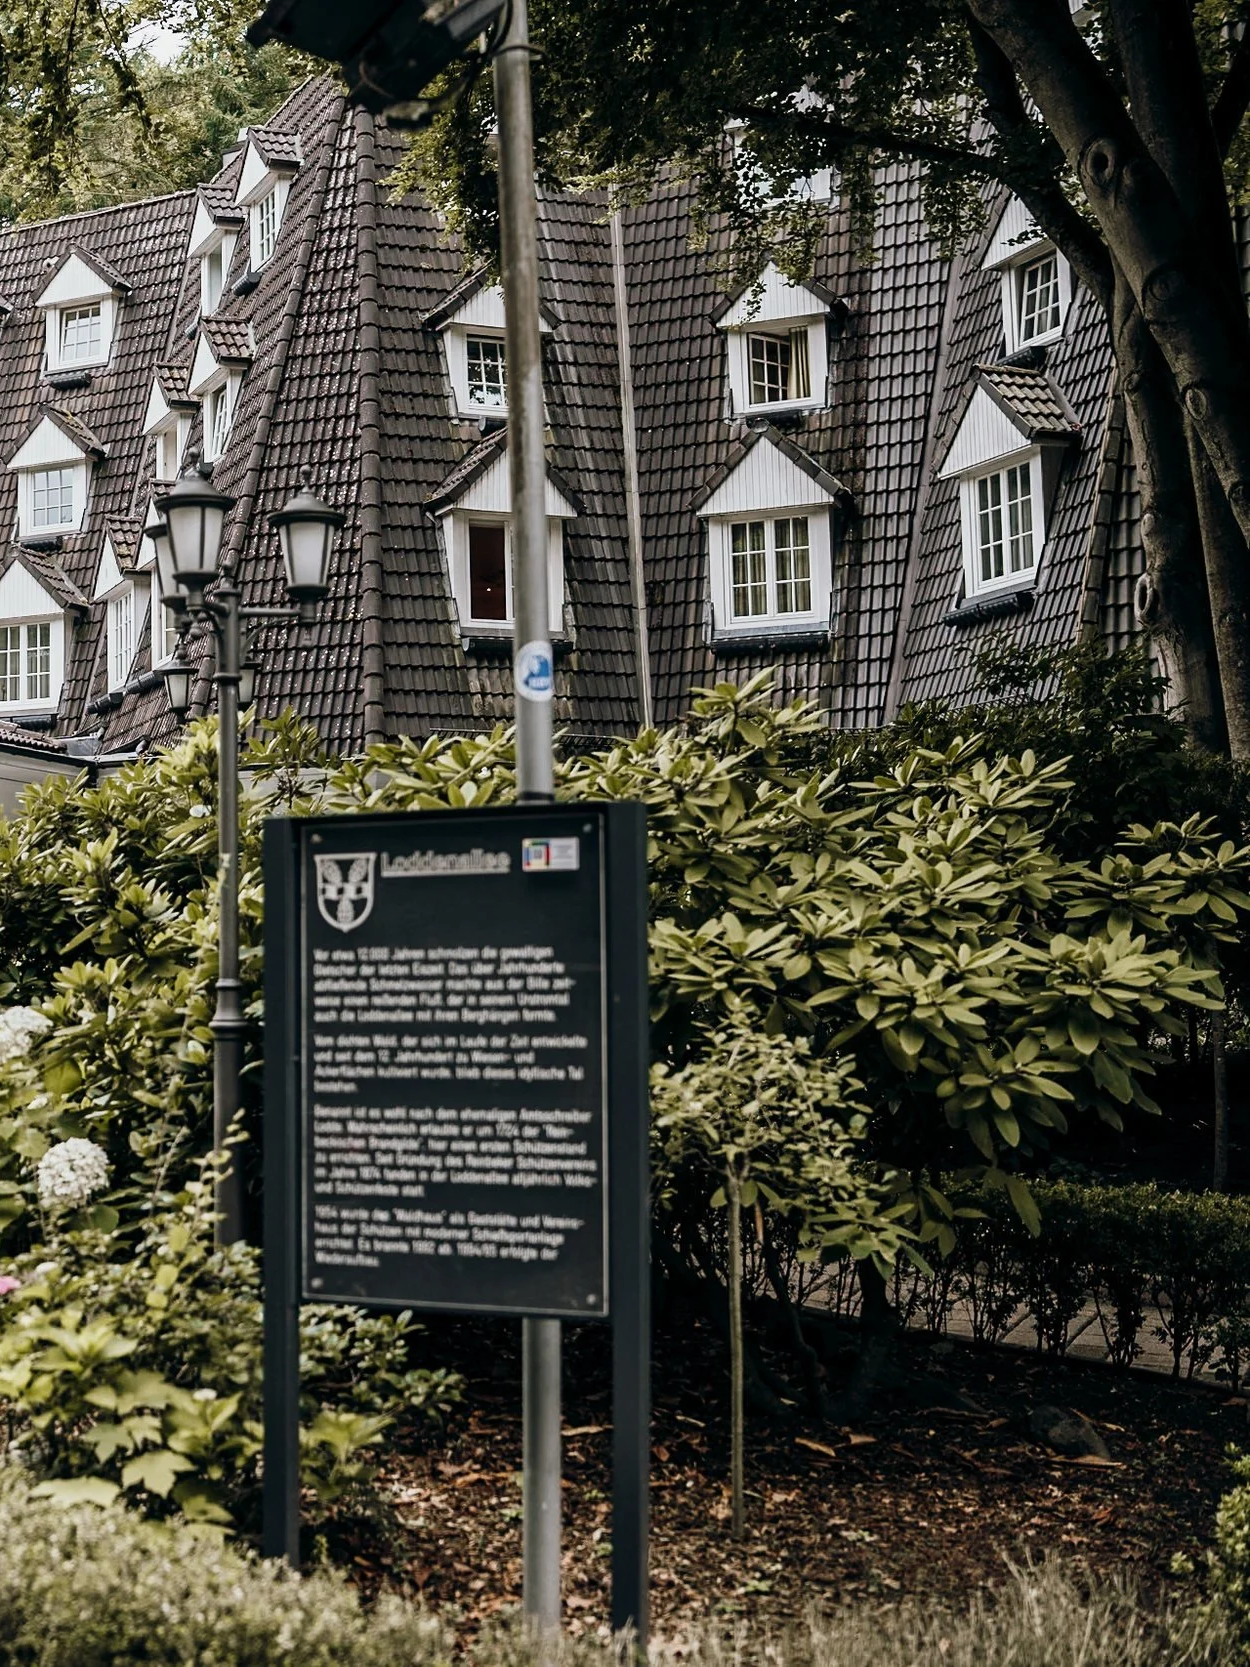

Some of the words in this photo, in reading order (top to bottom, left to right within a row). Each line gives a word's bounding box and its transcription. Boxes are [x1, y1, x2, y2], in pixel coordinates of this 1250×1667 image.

[380, 848, 510, 871] Loddenallee
[391, 947, 425, 960] Jahren
[481, 946, 498, 959] die
[359, 963, 375, 976] der
[497, 961, 565, 975] Jahrhunderte
[506, 977, 523, 990] der
[401, 1035, 418, 1047] der
[490, 1034, 508, 1048] der
[509, 1033, 530, 1048] Zeit
[314, 1049, 332, 1062] und
[394, 1049, 453, 1063] Jahrhundert
[513, 1050, 535, 1064] und
[517, 1066, 566, 1082] idyllische
[519, 1214, 540, 1228] und
